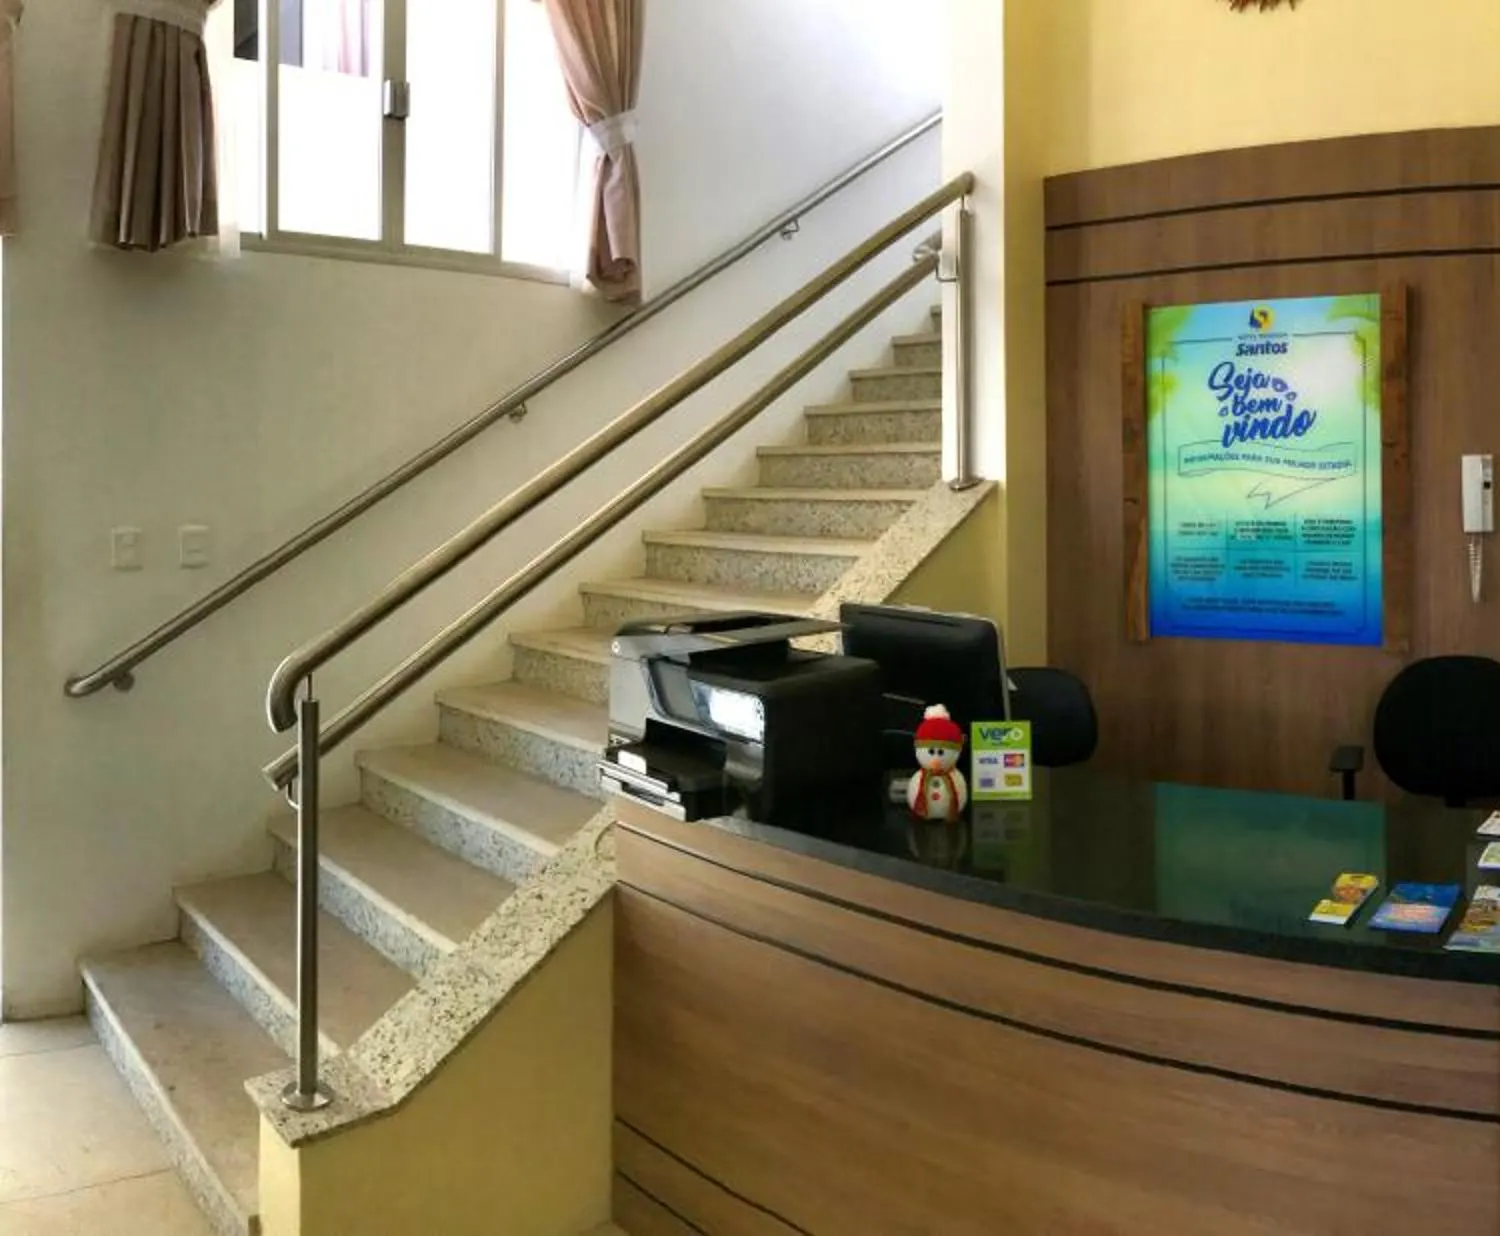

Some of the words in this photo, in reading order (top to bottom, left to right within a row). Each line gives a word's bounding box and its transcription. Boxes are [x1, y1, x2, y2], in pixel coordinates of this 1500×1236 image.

[1235, 340, 1288, 357] Santos
[1208, 361, 1270, 402] Seja
[1222, 403, 1316, 449] vindo
